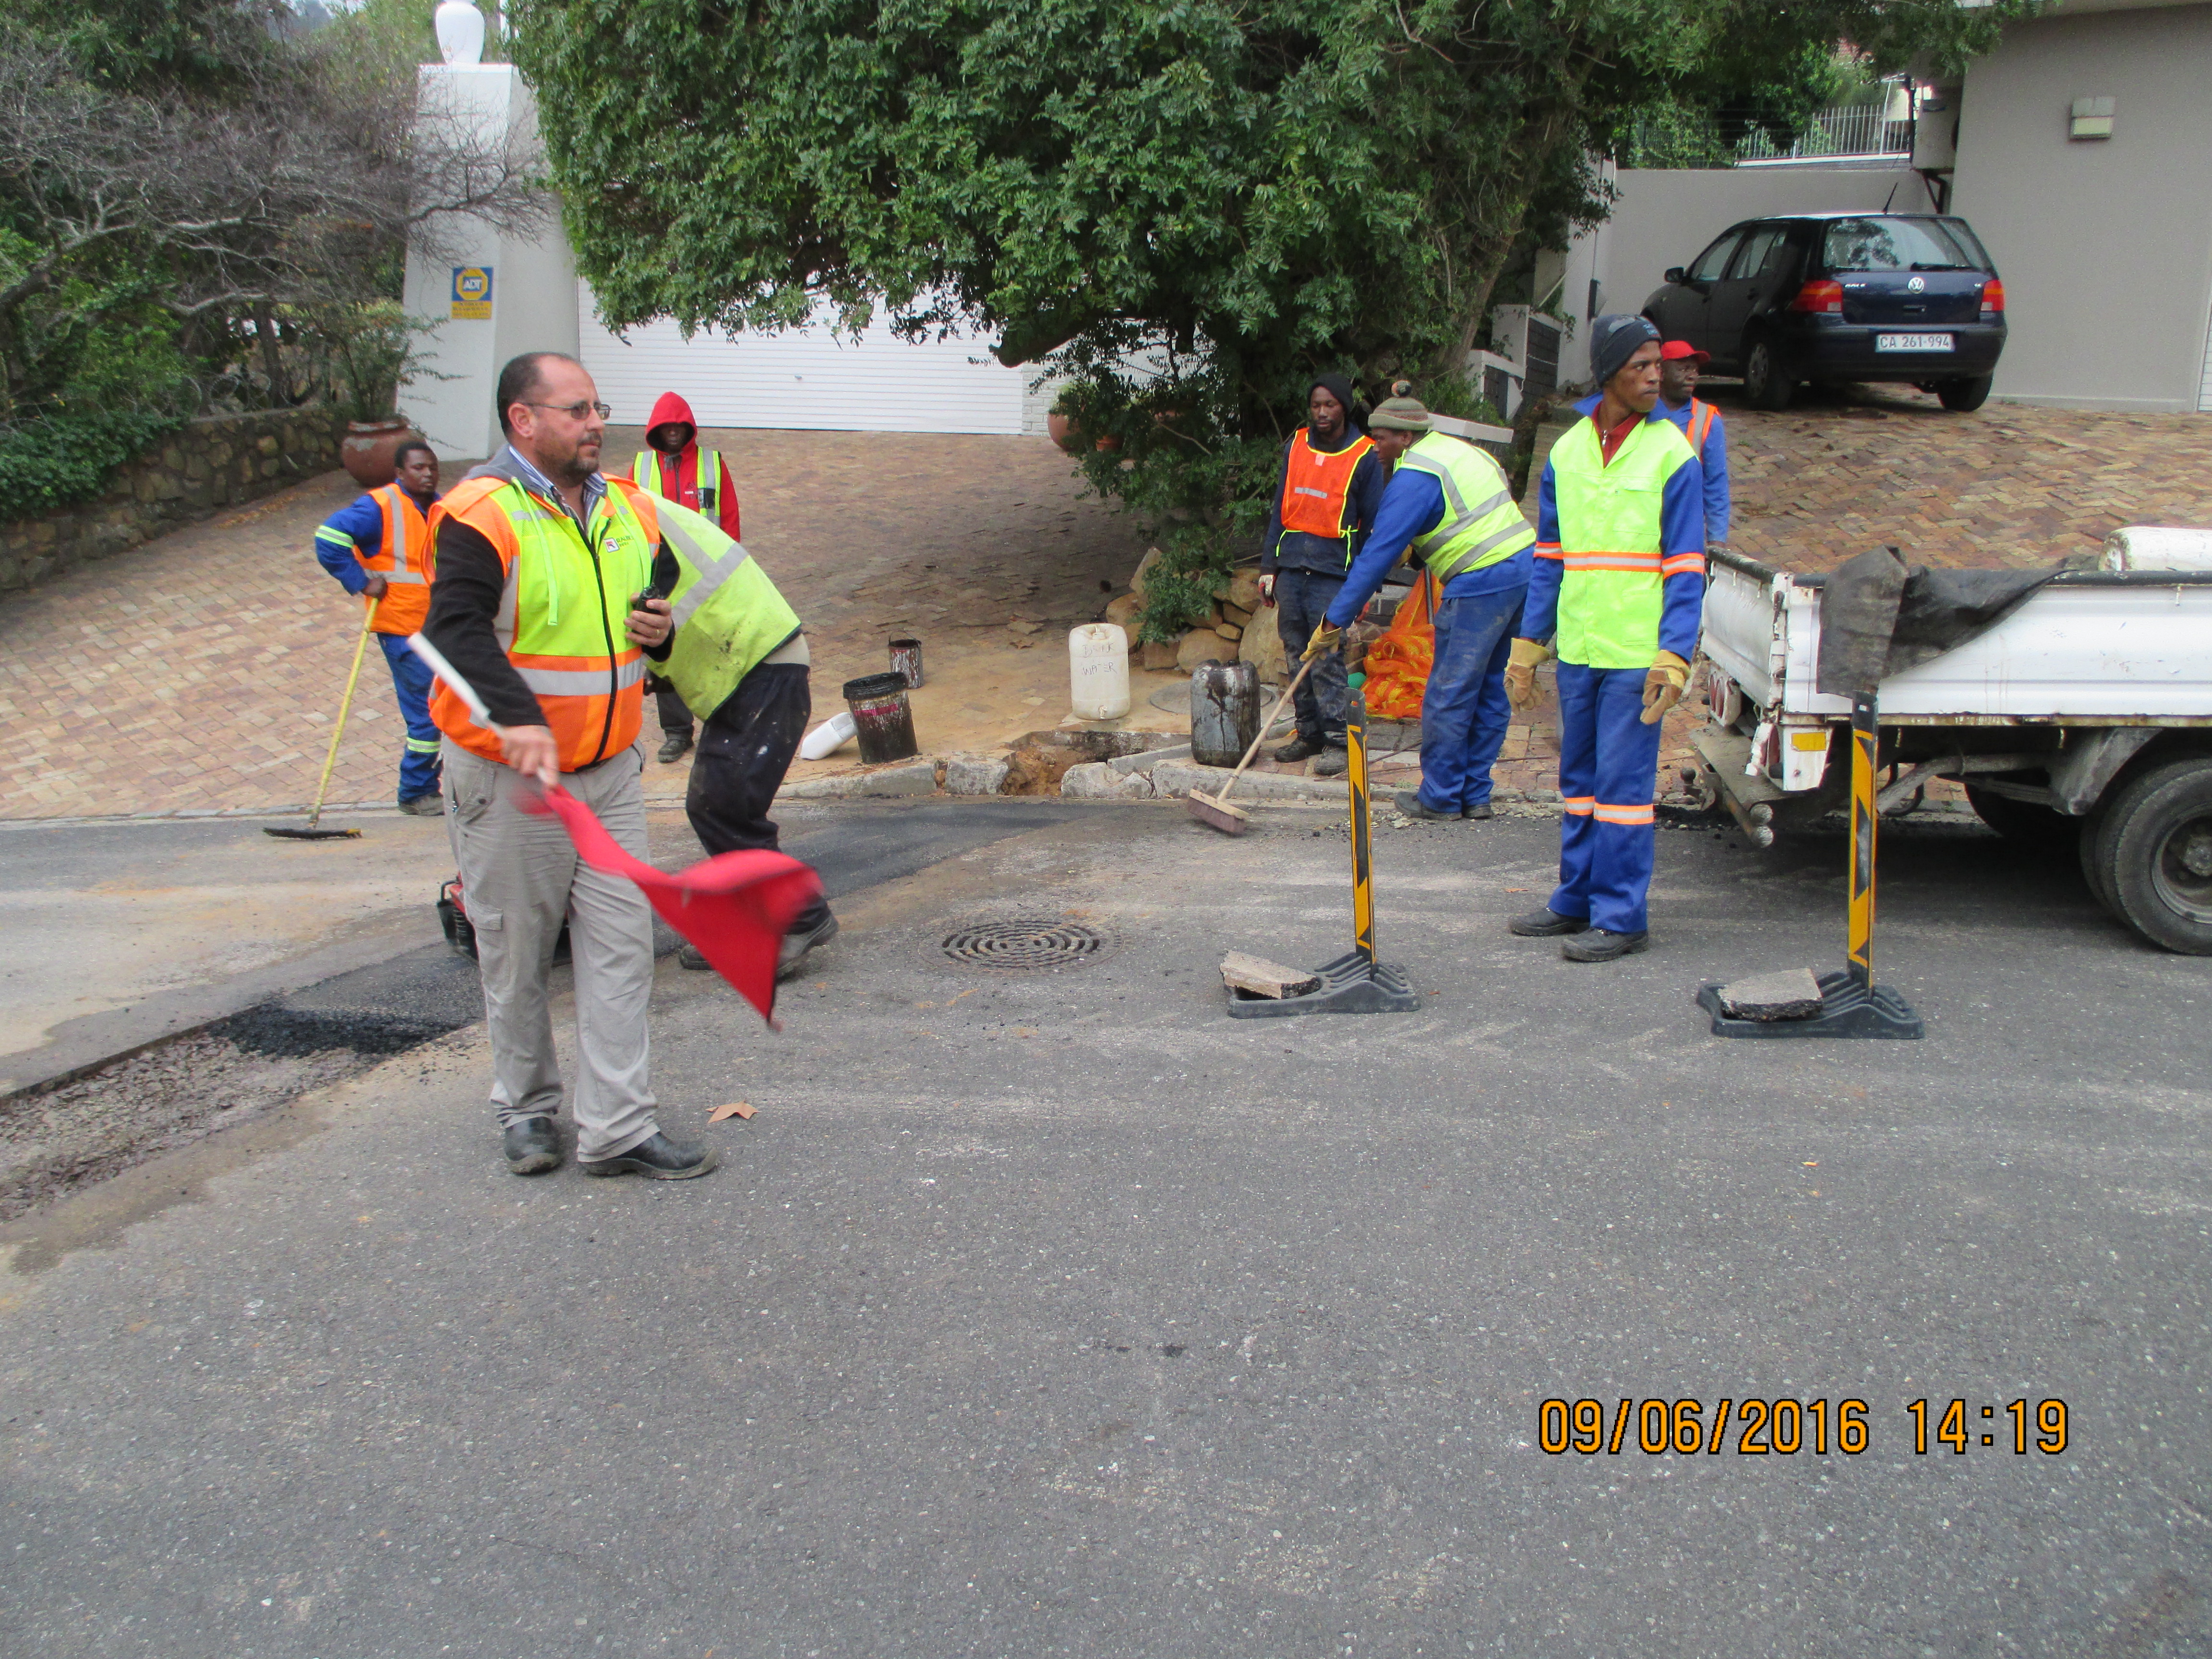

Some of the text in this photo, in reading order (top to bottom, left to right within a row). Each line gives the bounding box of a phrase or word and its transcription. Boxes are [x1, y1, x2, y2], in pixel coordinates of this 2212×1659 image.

[463, 279, 482, 290] ADT
[1880, 336, 1949, 348] CA 261-994
